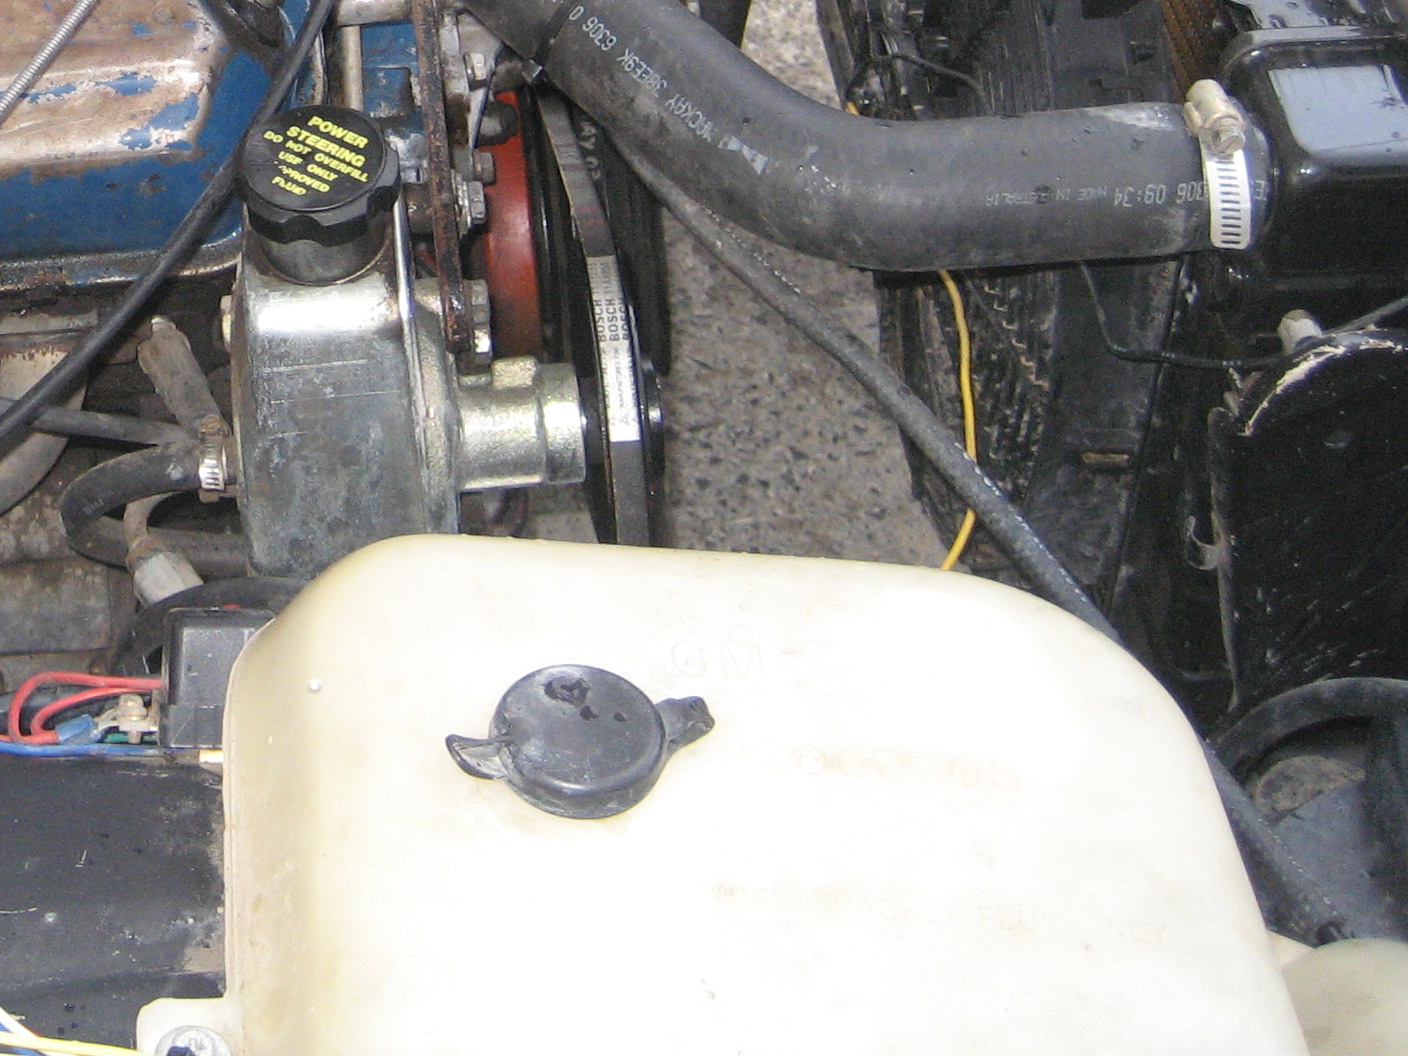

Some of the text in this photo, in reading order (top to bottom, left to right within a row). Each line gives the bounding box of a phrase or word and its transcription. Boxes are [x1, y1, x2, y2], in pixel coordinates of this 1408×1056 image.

[307, 115, 369, 149] POWER
[663, 90, 719, 142] MACKAY
[263, 131, 370, 183] DO NOT OVERFILL
[286, 126, 366, 168] STEERING
[278, 151, 339, 182] USE ONLY
[279, 166, 331, 193] PPROVED
[271, 176, 307, 196] FLUID
[605, 298, 619, 341] BOSCH
